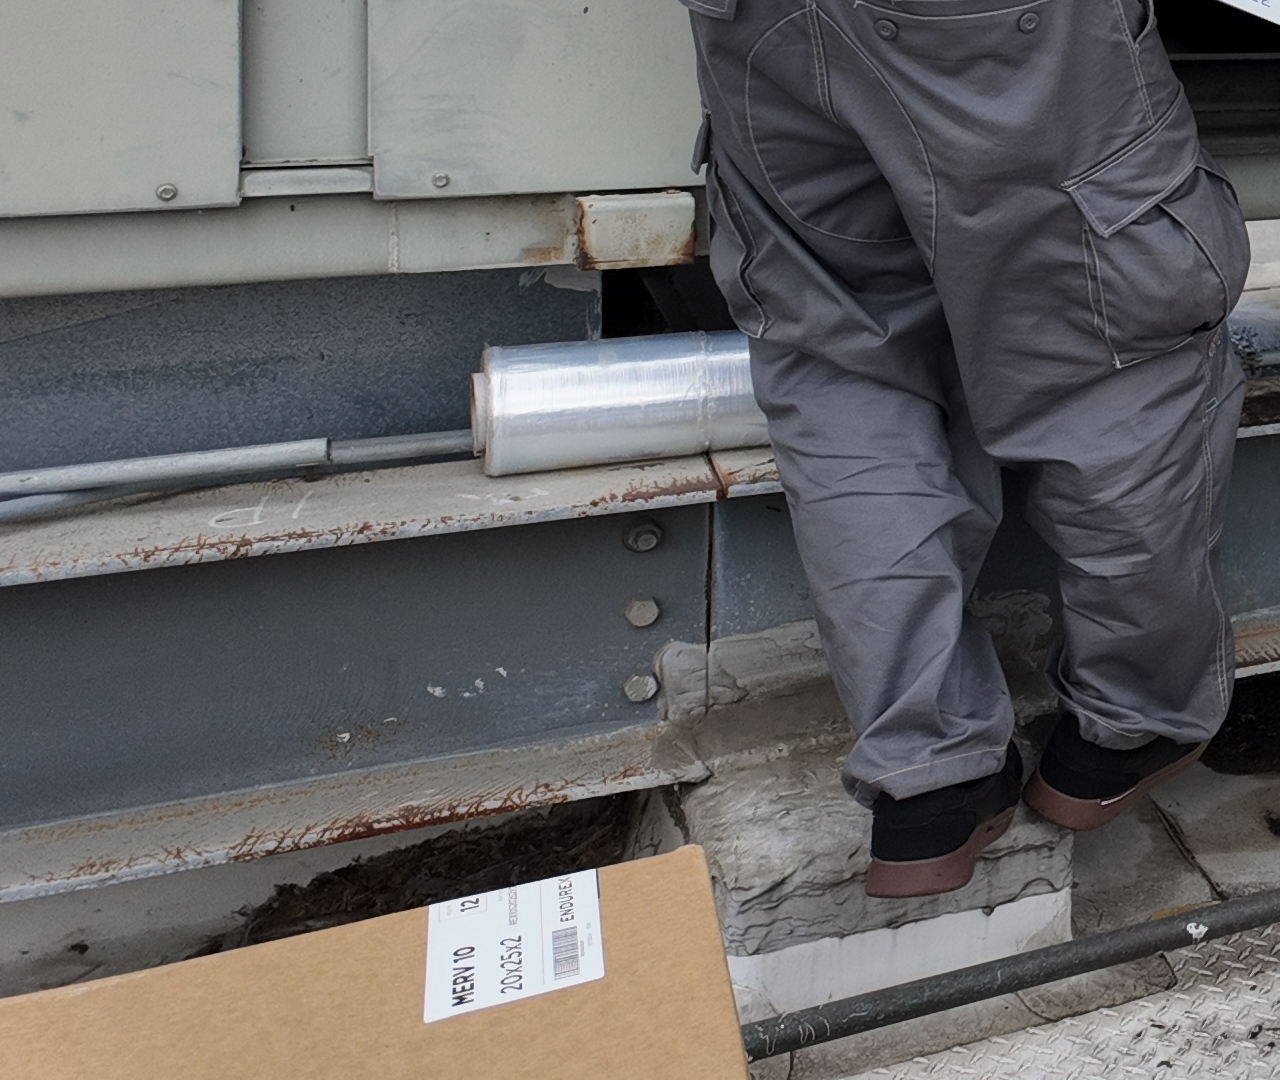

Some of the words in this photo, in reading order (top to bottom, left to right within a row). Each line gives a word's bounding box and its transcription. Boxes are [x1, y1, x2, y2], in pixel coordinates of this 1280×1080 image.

[460, 897, 480, 913] 12
[558, 876, 575, 923] ENDUREX
[453, 946, 476, 964] 10
[500, 935, 523, 995] 20x25x2
[451, 966, 475, 1008] MERV
